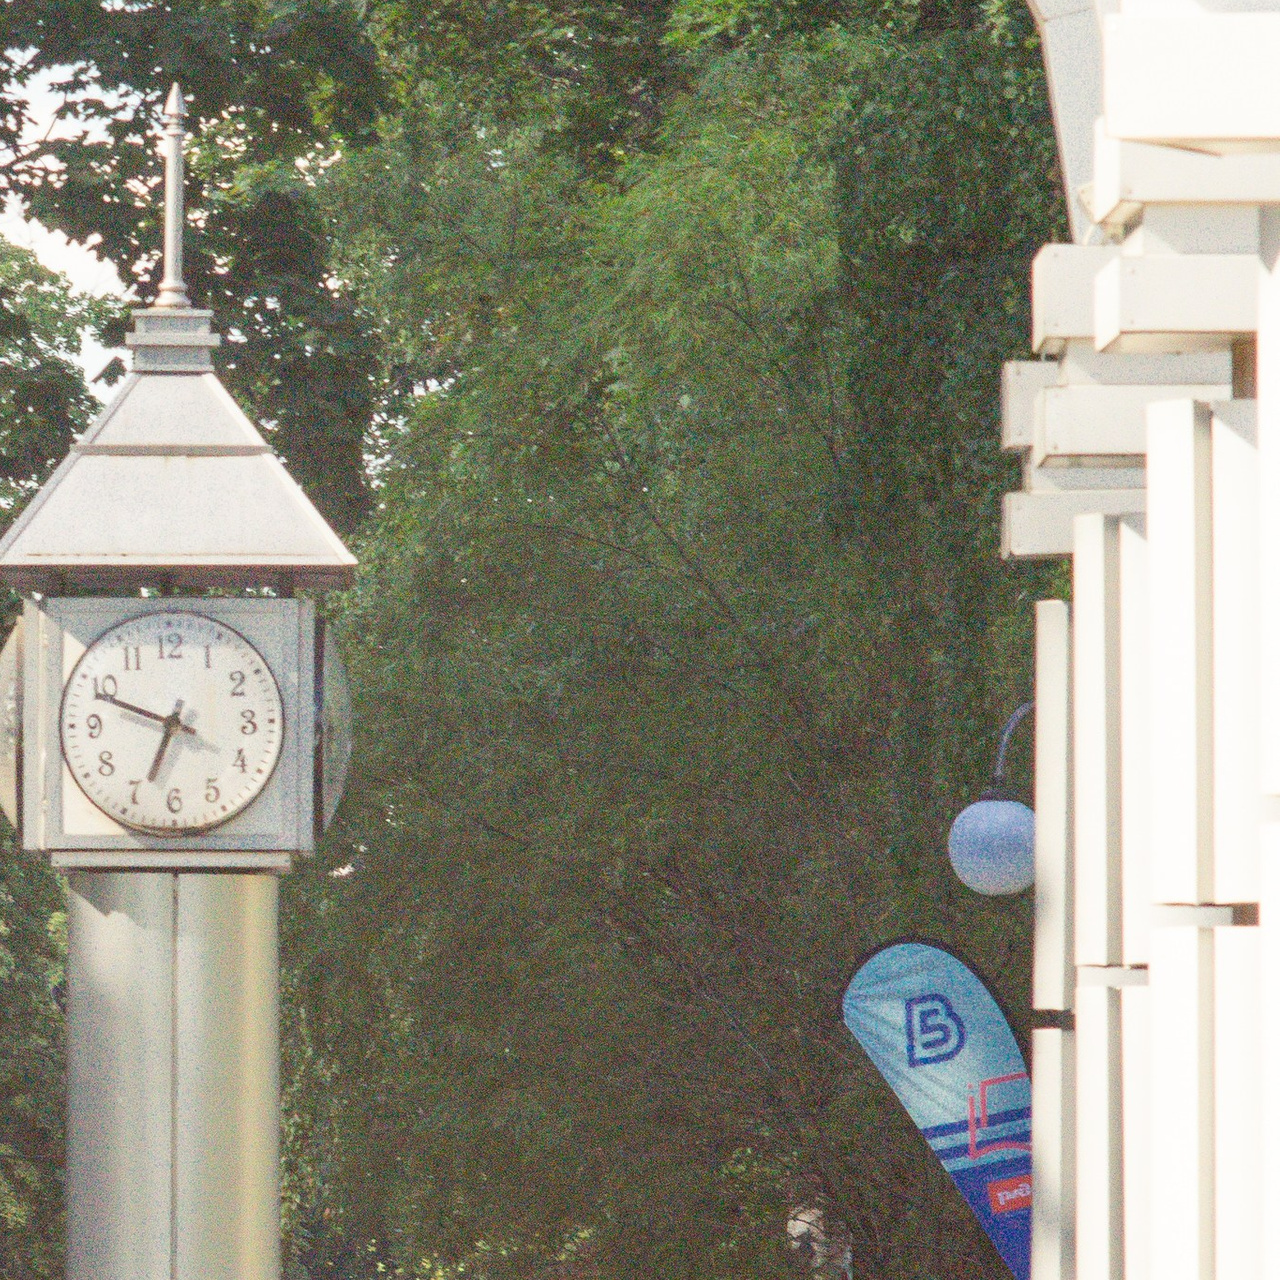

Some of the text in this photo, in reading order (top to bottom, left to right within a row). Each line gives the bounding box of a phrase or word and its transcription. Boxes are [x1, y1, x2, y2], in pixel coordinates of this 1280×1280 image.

[123, 645, 141, 671] 11
[157, 632, 183, 659] 12
[203, 644, 212, 669] 1
[93, 674, 117, 698] 10
[229, 670, 246, 697] 2
[86, 713, 103, 739] 9
[240, 709, 258, 735] 3
[98, 750, 115, 777] 8
[232, 748, 248, 773] 4
[128, 780, 144, 805] 7
[166, 787, 183, 814] 6
[204, 777, 220, 803] 5
